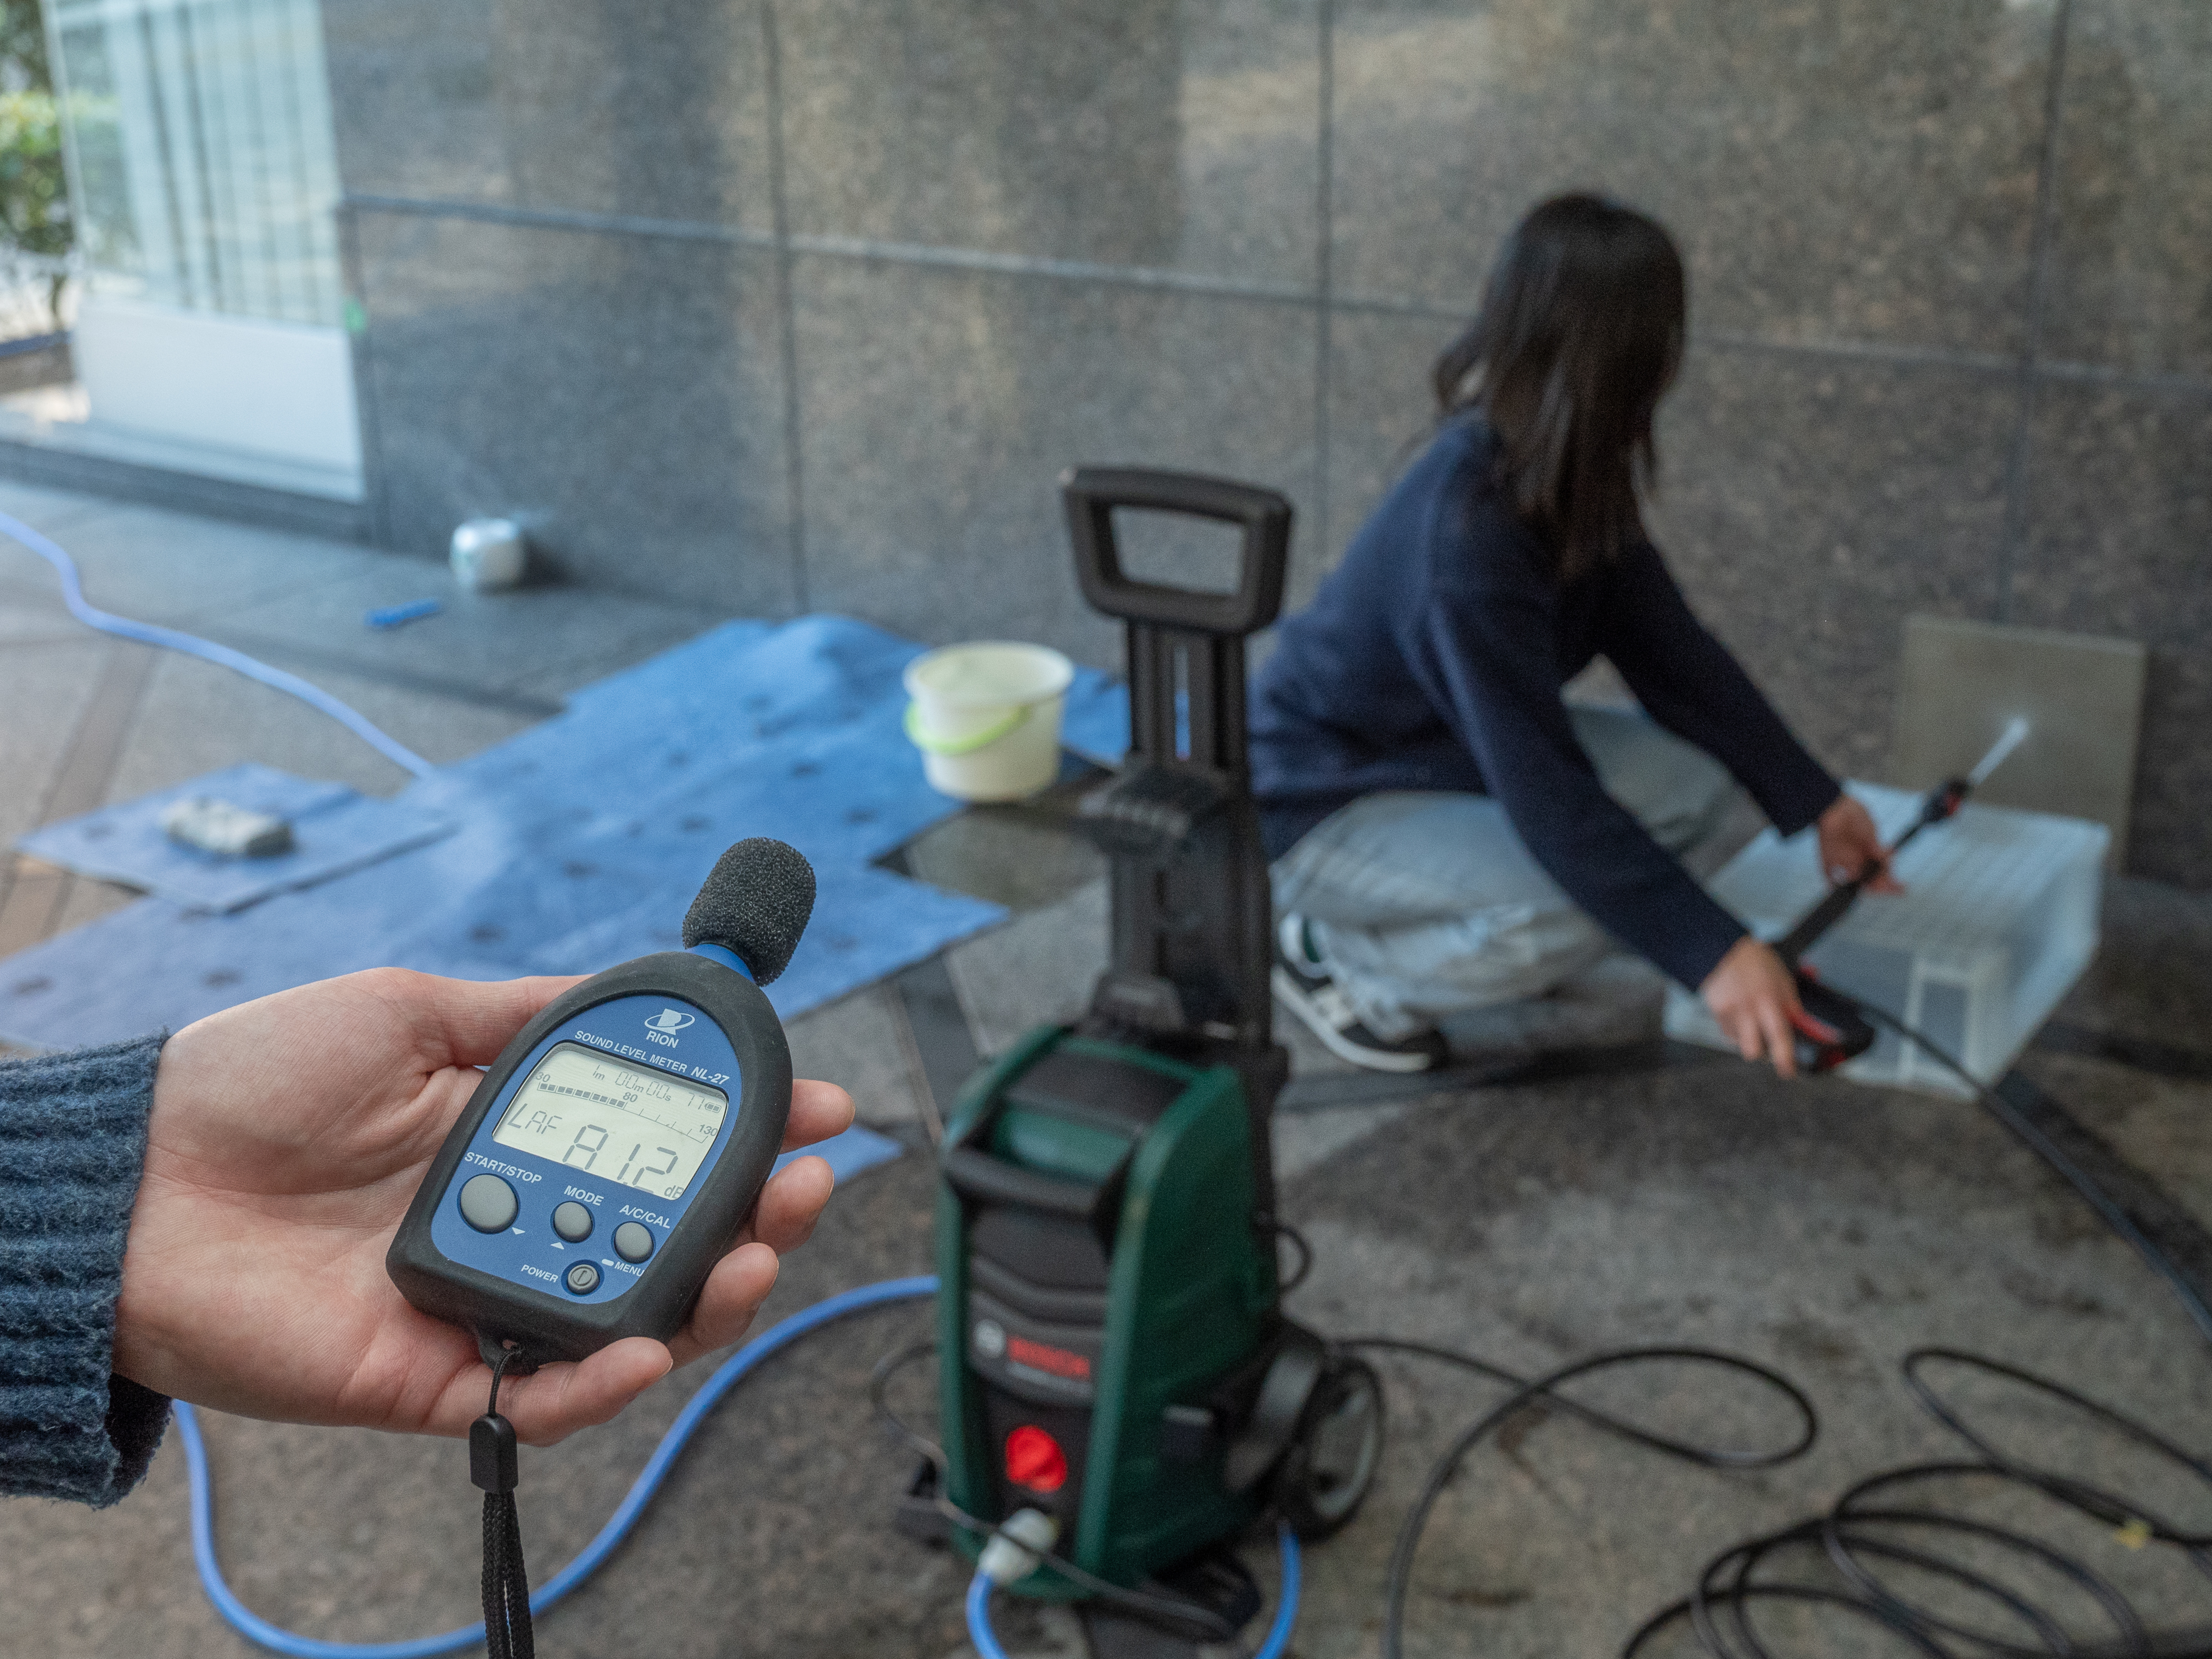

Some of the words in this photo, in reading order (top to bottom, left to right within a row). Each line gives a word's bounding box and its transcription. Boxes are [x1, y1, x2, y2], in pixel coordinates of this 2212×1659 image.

[645, 1030, 679, 1048] RION
[575, 1030, 614, 1049] SOUND
[614, 1044, 646, 1061] LEVEL
[649, 1053, 687, 1073] METER
[690, 1066, 730, 1085] NL-27
[535, 1072, 551, 1082] 30
[622, 1092, 638, 1103] 80
[699, 1124, 718, 1137] 130
[464, 1151, 542, 1184] START/STOP
[564, 1185, 604, 1206] MODE
[664, 1185, 685, 1199] dB
[619, 1204, 671, 1229] A/C/CAL
[520, 1264, 559, 1283] POWER
[614, 1261, 645, 1277] MENU
